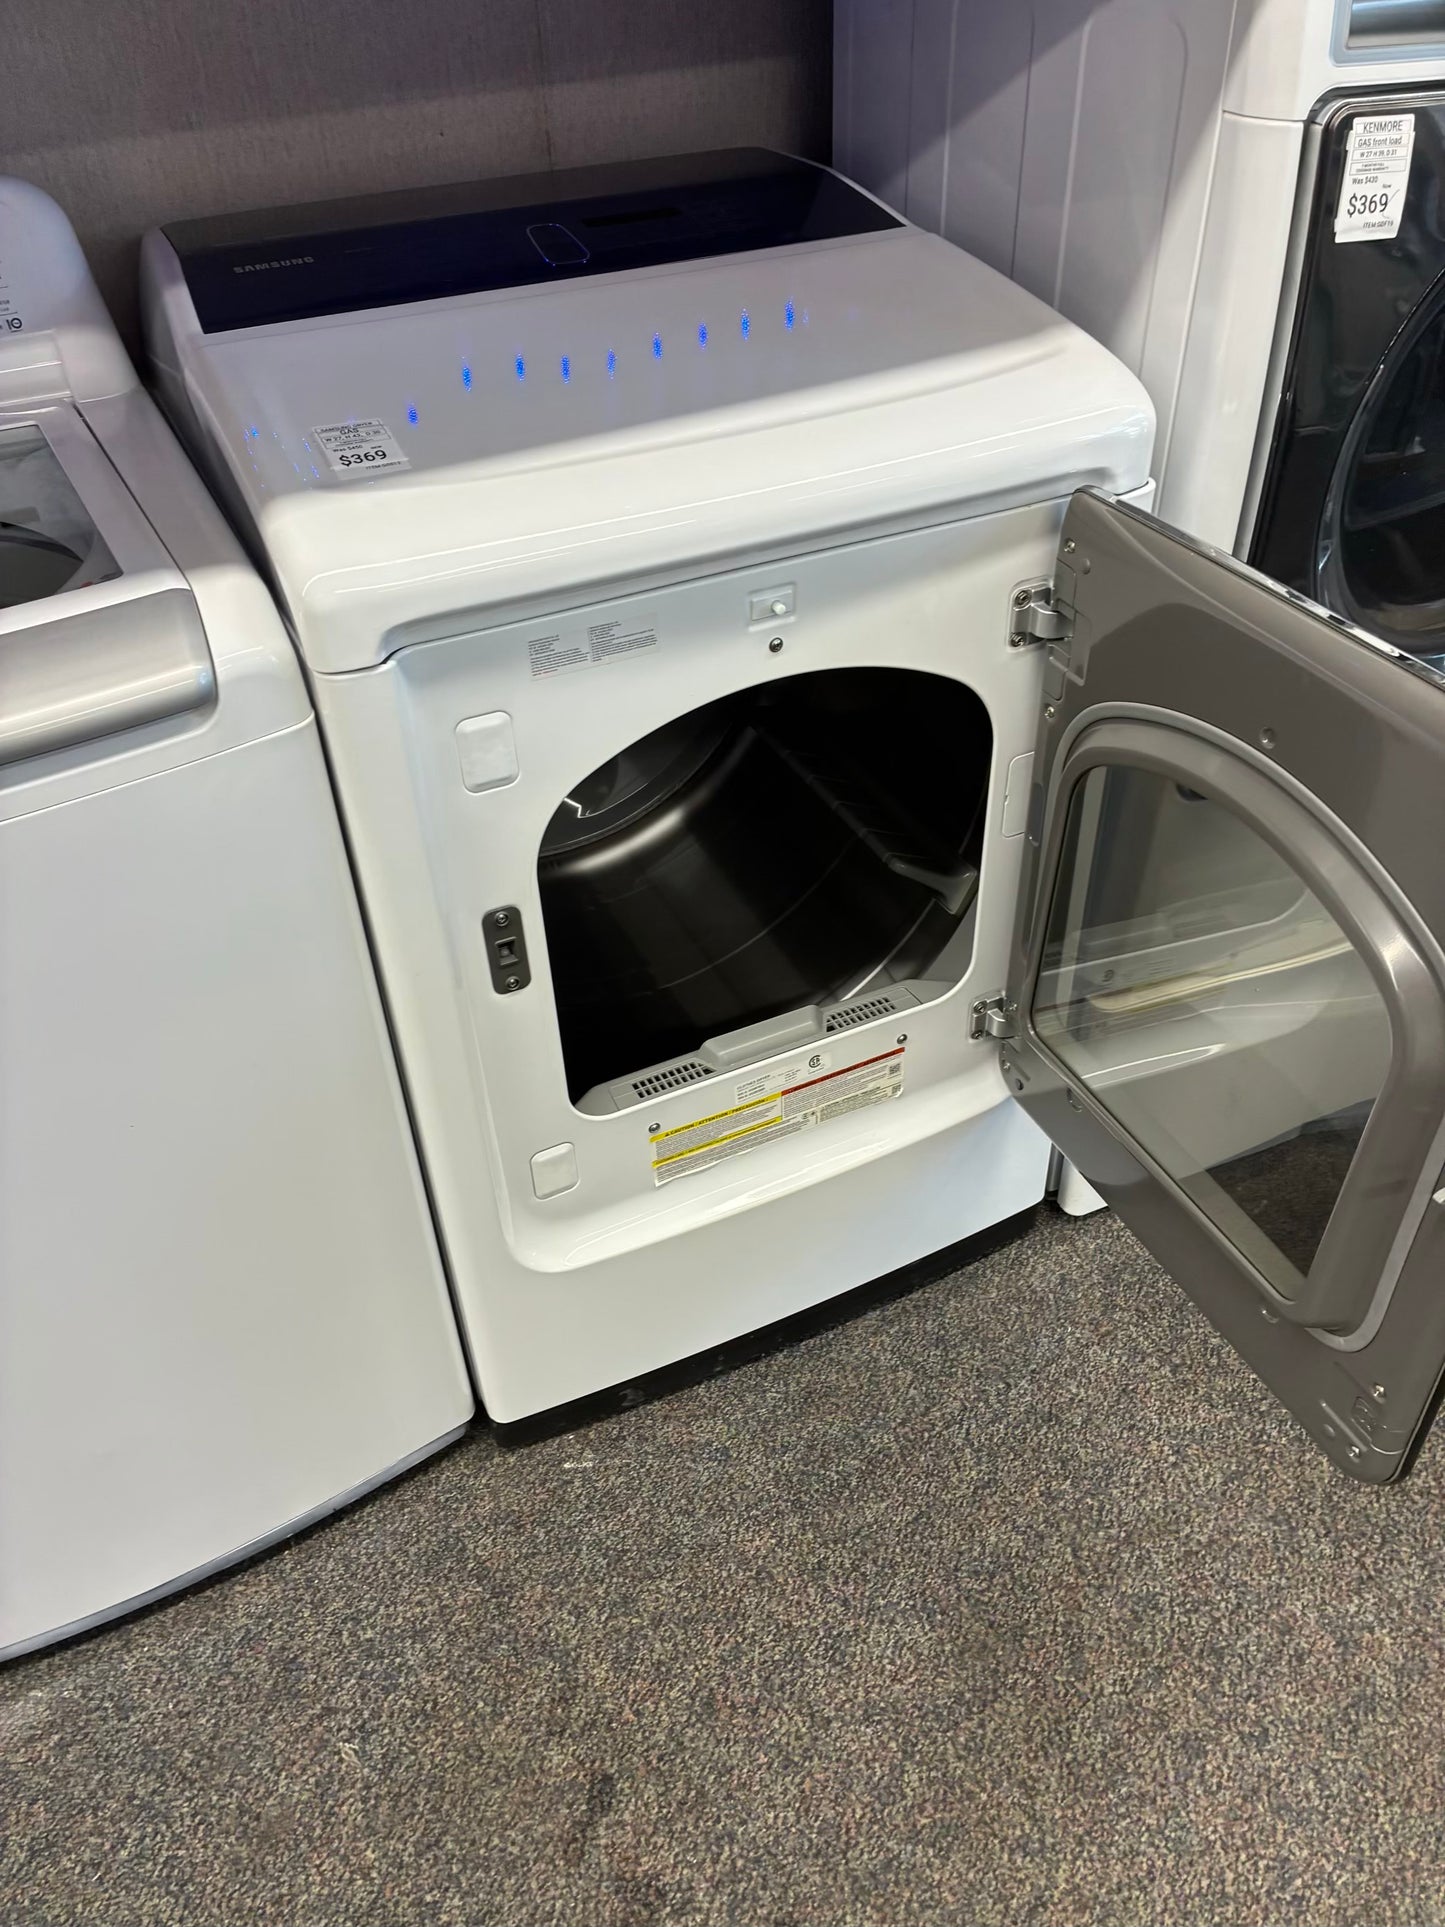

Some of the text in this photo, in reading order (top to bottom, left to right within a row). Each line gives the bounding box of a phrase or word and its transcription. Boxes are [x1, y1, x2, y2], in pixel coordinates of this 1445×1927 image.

[1363, 120, 1404, 134] KENMORE
[1358, 135, 1403, 148] GAS front load
[1352, 177, 1364, 185] Was
[1347, 192, 1389, 218] $369
[233, 256, 315, 273] SAMSUNG
[340, 427, 359, 436] GAS
[339, 449, 387, 467] $369
